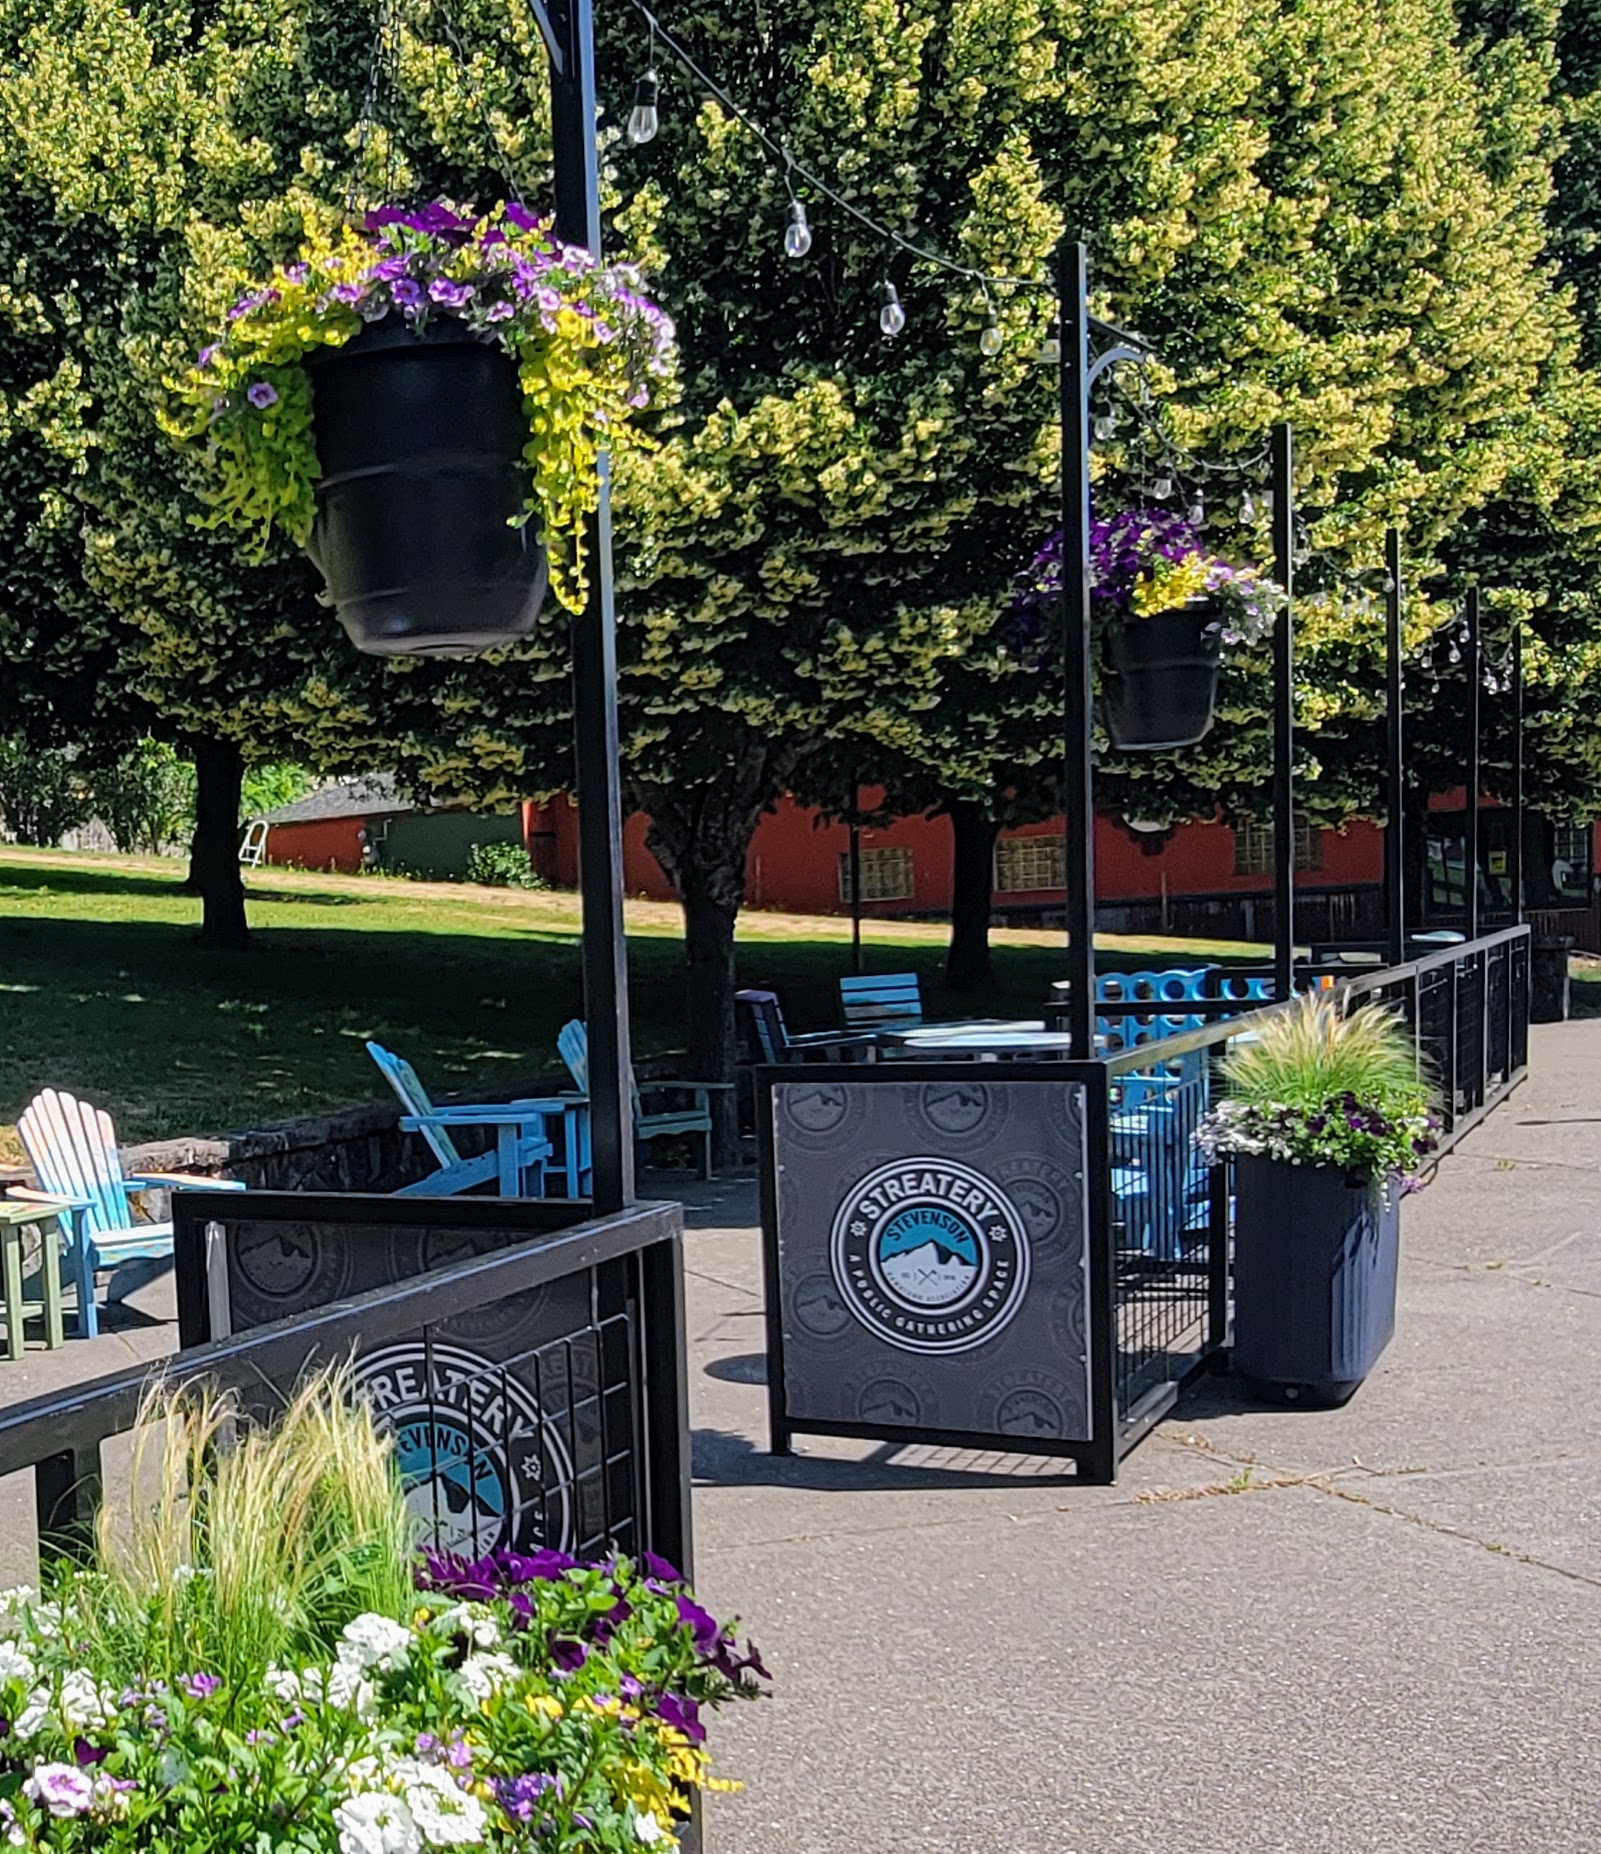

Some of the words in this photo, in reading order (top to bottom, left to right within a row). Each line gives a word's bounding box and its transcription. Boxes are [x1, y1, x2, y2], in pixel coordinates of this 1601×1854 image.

[859, 1172, 999, 1221] STREATERY
[887, 1210, 969, 1243] STEVENSON
[848, 1254, 861, 1262] A
[852, 1269, 892, 1319] PUBLIC
[983, 1260, 1009, 1309] SPACE
[895, 1309, 984, 1335] GATHERING
